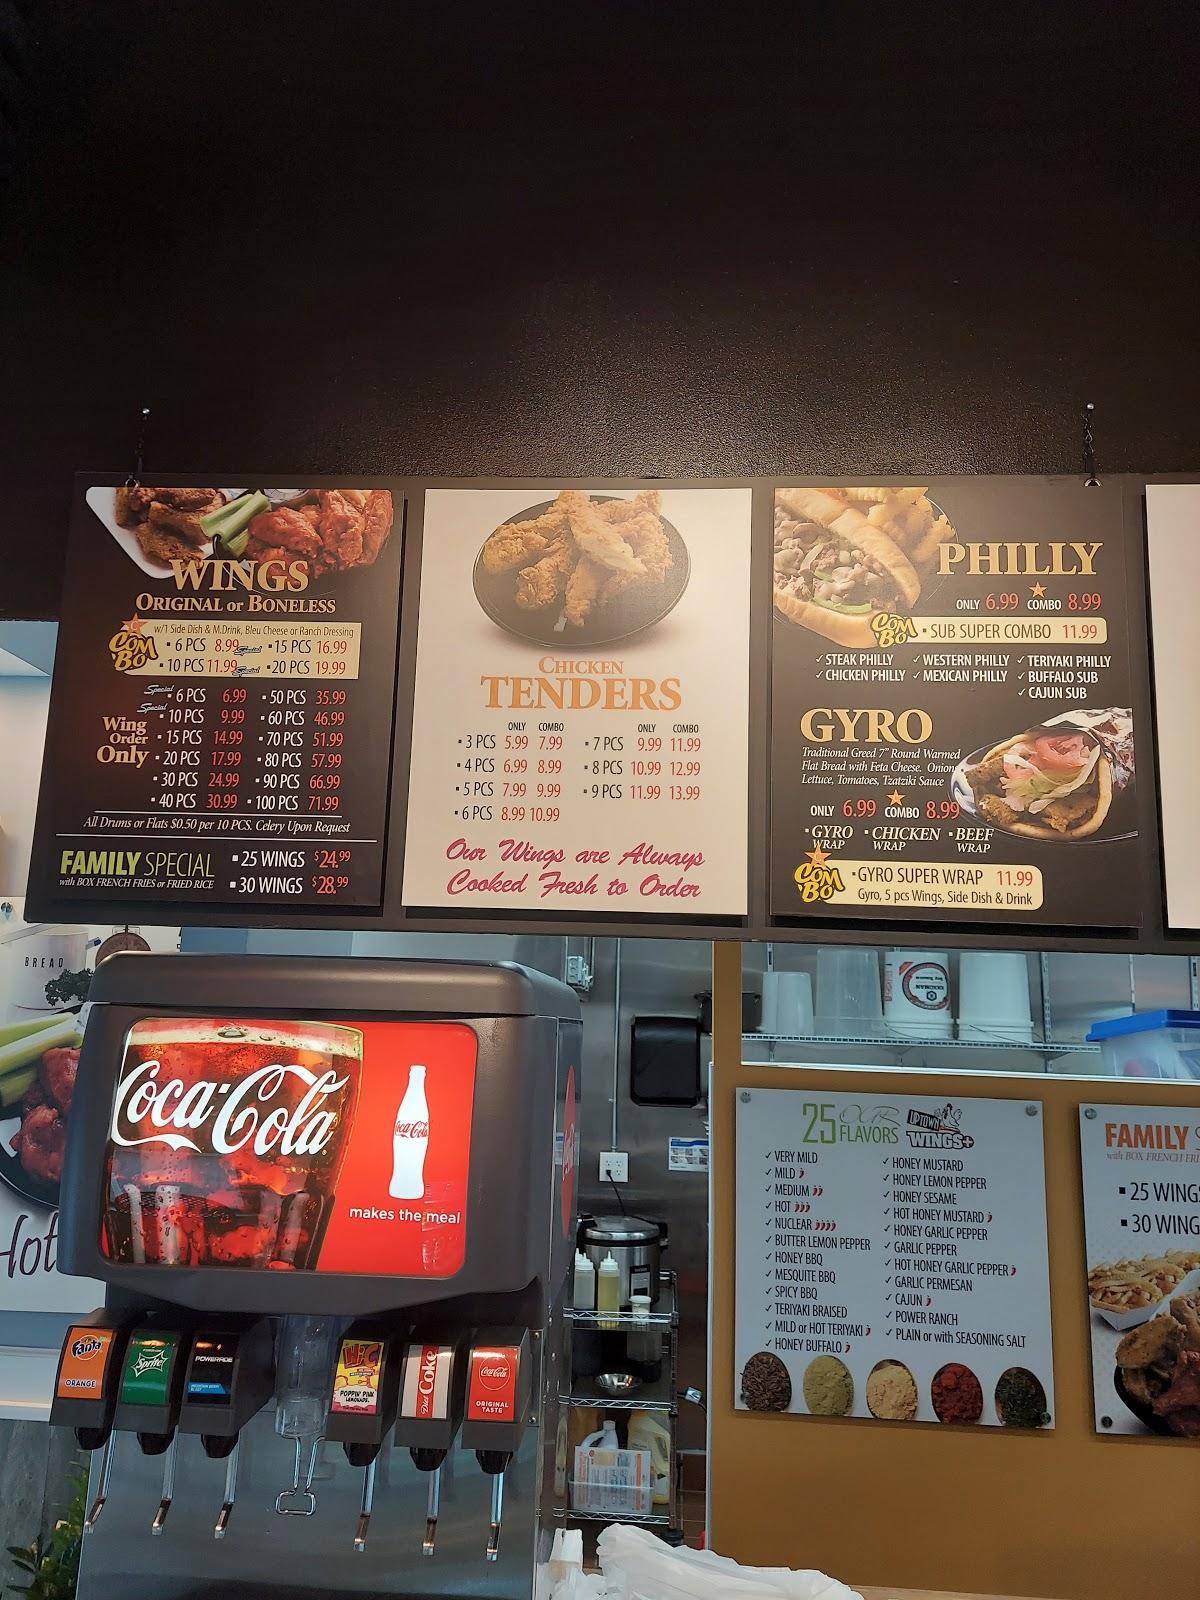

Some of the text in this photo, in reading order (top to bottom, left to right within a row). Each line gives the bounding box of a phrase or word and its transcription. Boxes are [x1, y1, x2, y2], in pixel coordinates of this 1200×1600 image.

[937, 542, 1103, 576] PHILLY
[169, 559, 309, 591] WINGS
[226, 598, 244, 612] or
[956, 593, 1101, 610] ONLY 6.99 COMBO 8.99
[170, 624, 185, 633] Side
[187, 625, 203, 634] Dish
[205, 625, 211, 634] &
[246, 626, 261, 634] Bleu
[263, 626, 288, 635] Cheese
[299, 626, 321, 636] Ranch
[323, 627, 354, 637] Dressing
[931, 624, 1097, 639] SUB SUPER COMBO 11.99
[176, 638, 239, 652] 6 PCS 8.99
[275, 640, 347, 654] 15 PCS 16.99
[167, 659, 237, 672] 10 PCS 11.99
[923, 655, 1009, 667] WESTERN PHILLY
[1027, 655, 1111, 668] TERIYAKI PHILLY
[176, 689, 246, 702] 6 PCS 6.99
[271, 690, 346, 704] 50 PCS 35.99
[480, 676, 681, 711] TENDERS
[103, 717, 147, 734] Wing
[508, 722, 564, 732] ONLY COMBO
[800, 708, 933, 744] GYRO
[110, 733, 148, 745] Order
[466, 735, 563, 750] 3 PCS 5.99 7.99
[96, 747, 150, 768] Only
[803, 747, 960, 760] Traditional Greed Round Warmed
[882, 775, 917, 786] Tzatziki
[918, 776, 944, 786] Sauce
[255, 795, 339, 811] 100 PCS 71.99
[83, 815, 99, 828] All
[100, 817, 130, 828] Drums
[133, 820, 144, 829] or
[147, 818, 168, 830] Flats
[171, 817, 197, 830] $0.50
[199, 821, 214, 832] per
[218, 818, 228, 830] 10
[255, 820, 284, 834] Celery
[287, 821, 312, 835] Upon
[315, 821, 350, 834] Request
[812, 825, 994, 841] GYRO CHICKEN BEEF
[242, 851, 257, 867] 25
[260, 852, 305, 868] WINGS
[446, 838, 705, 872] Our Wings are Always
[60, 851, 214, 877] FAMILY SPECIAL
[59, 878, 75, 886] with
[77, 878, 94, 887] BOX
[96, 878, 131, 887] FRENCH
[133, 879, 155, 888] FRIES
[167, 879, 192, 889] FRIED
[194, 880, 214, 889] RICE
[447, 869, 701, 897] Cooked Fresh to Order
[858, 867, 1033, 886] GYRO SUPER WRAP 11.99
[858, 887, 1032, 905] Gyro, 5 pcs Wings, Side Dish & Drink
[25, 957, 63, 967] BREAD
[111, 1060, 350, 1156] Coca-Cola
[802, 1104, 836, 1143] 25
[907, 1109, 941, 1131] UPTOWN
[840, 1126, 899, 1144] FLAVORS
[1105, 1123, 1189, 1150] FAMILY
[775, 1151, 817, 1163] VERY MILD
[893, 1174, 986, 1189] HONEY LEMON PEPPER
[1130, 1182, 1149, 1200] 25
[349, 1207, 460, 1224] makes the meal
[775, 1218, 812, 1230] NUCLEAR
[775, 1270, 835, 1284] MESQUITE BBQ
[895, 1276, 972, 1291] GARLIC PERMESAN
[896, 1329, 1026, 1347] PLAIN or with SEASONING SALT
[72, 1339, 101, 1357] Fanta
[136, 1358, 163, 1369] Sprite
[419, 1351, 437, 1394] Coke
[421, 1395, 429, 1414] Diet
